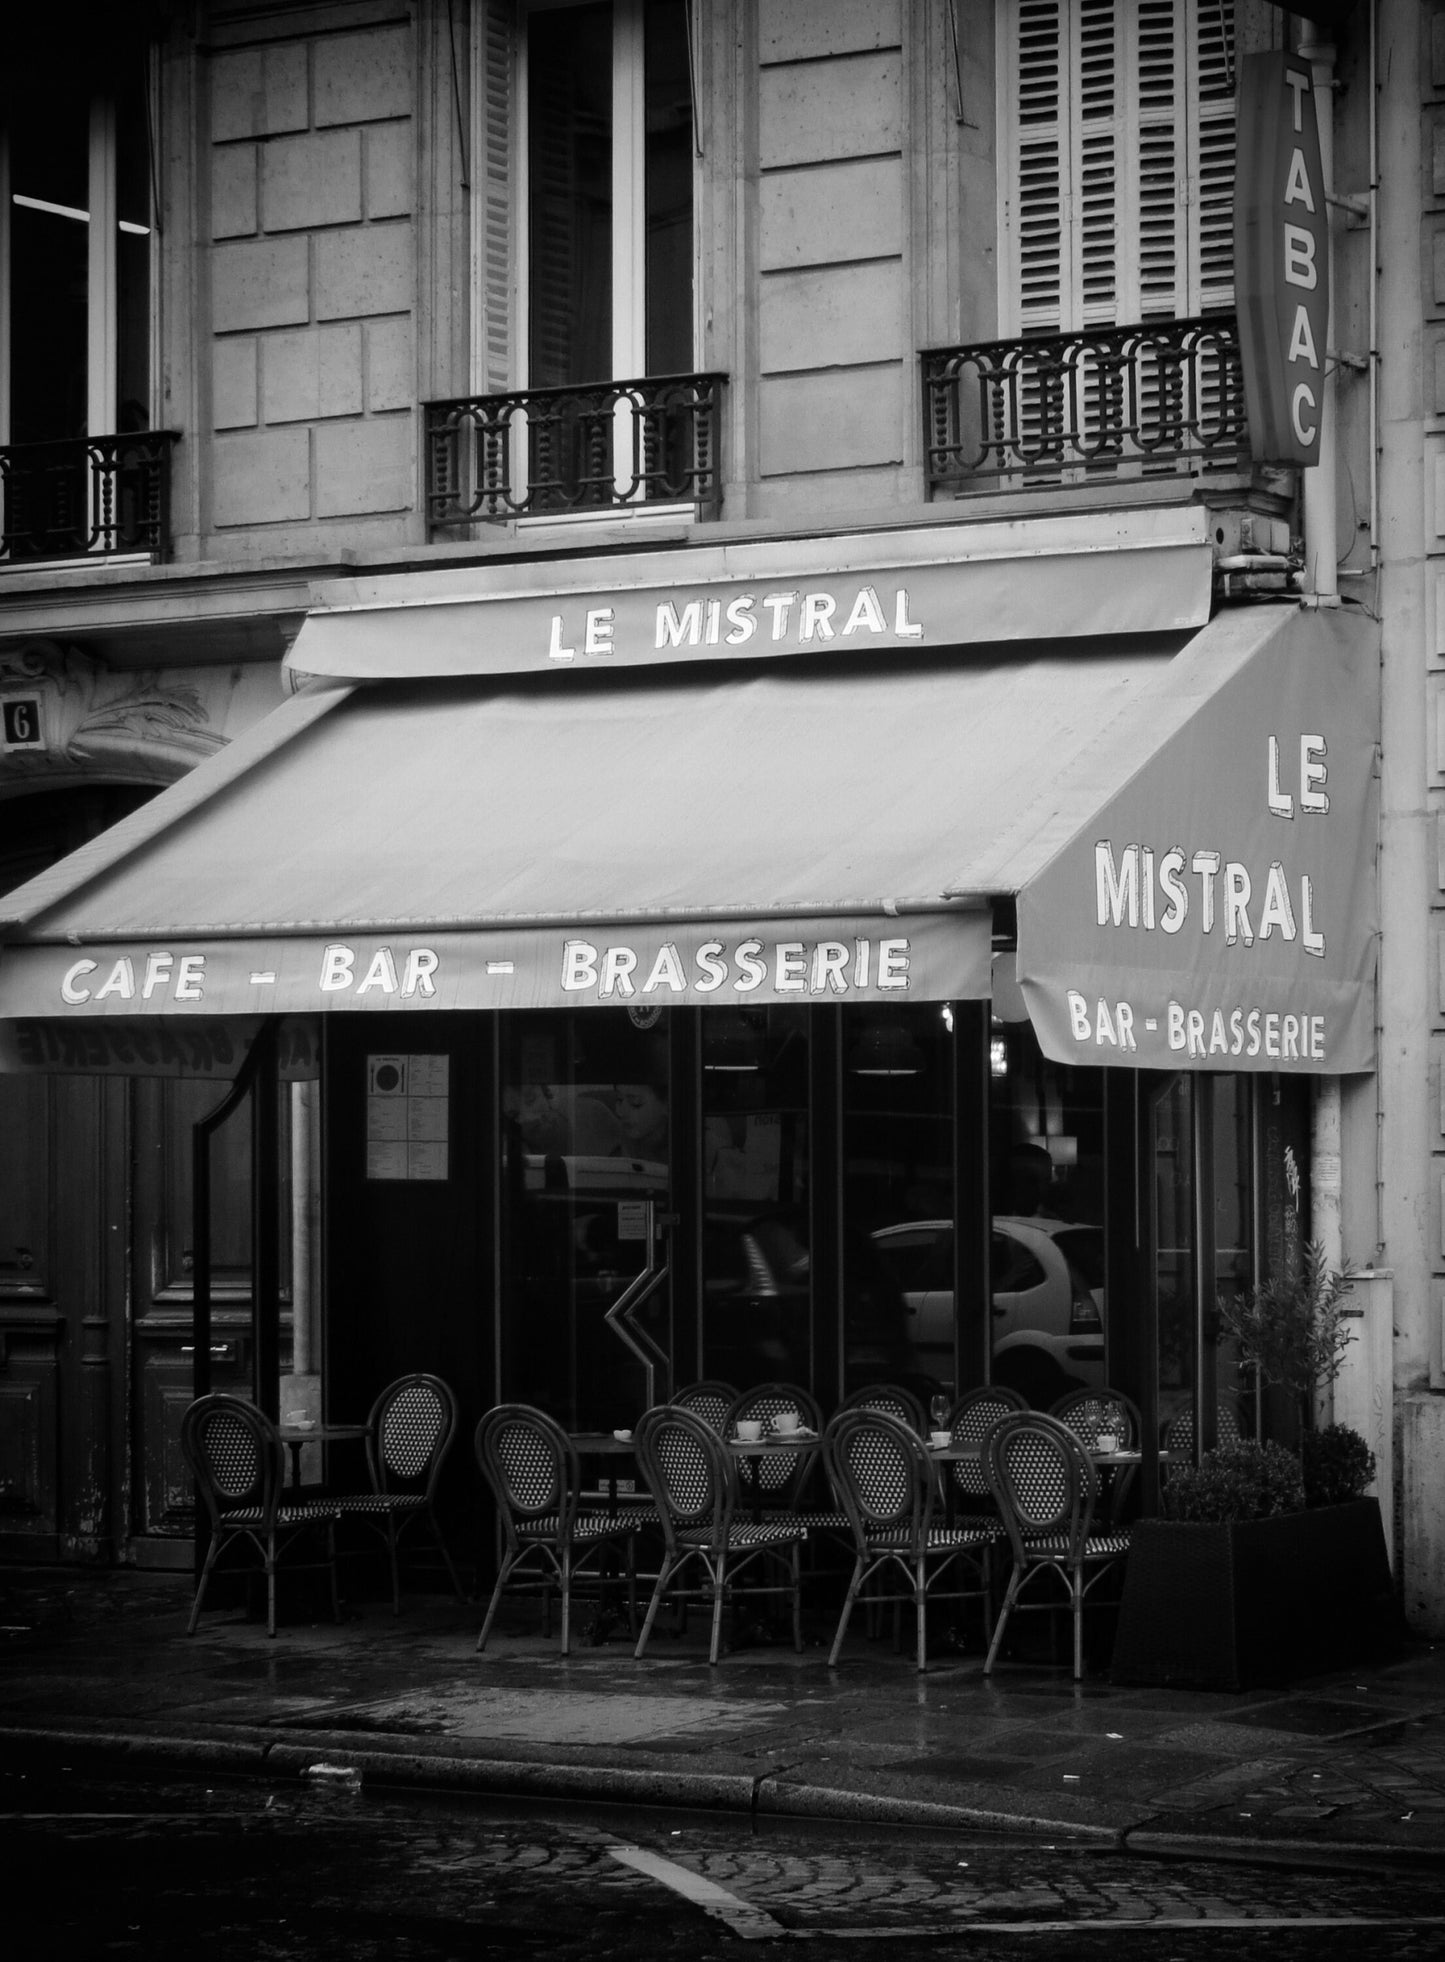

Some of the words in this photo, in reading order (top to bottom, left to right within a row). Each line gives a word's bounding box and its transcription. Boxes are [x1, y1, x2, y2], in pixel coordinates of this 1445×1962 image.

[1284, 66, 1320, 447] TABAC
[549, 608, 615, 662] LE
[655, 585, 924, 649] MISTRAL
[13, 705, 31, 739] 6
[1268, 733, 1330, 820] LE
[1095, 839, 1326, 958] MISTRAL
[60, 952, 206, 1005] CAFE
[318, 943, 440, 999] BAR
[561, 937, 911, 999] BRASSERIE
[1066, 989, 1137, 1052] BAR
[1167, 1000, 1326, 1061] BRASSERIE
